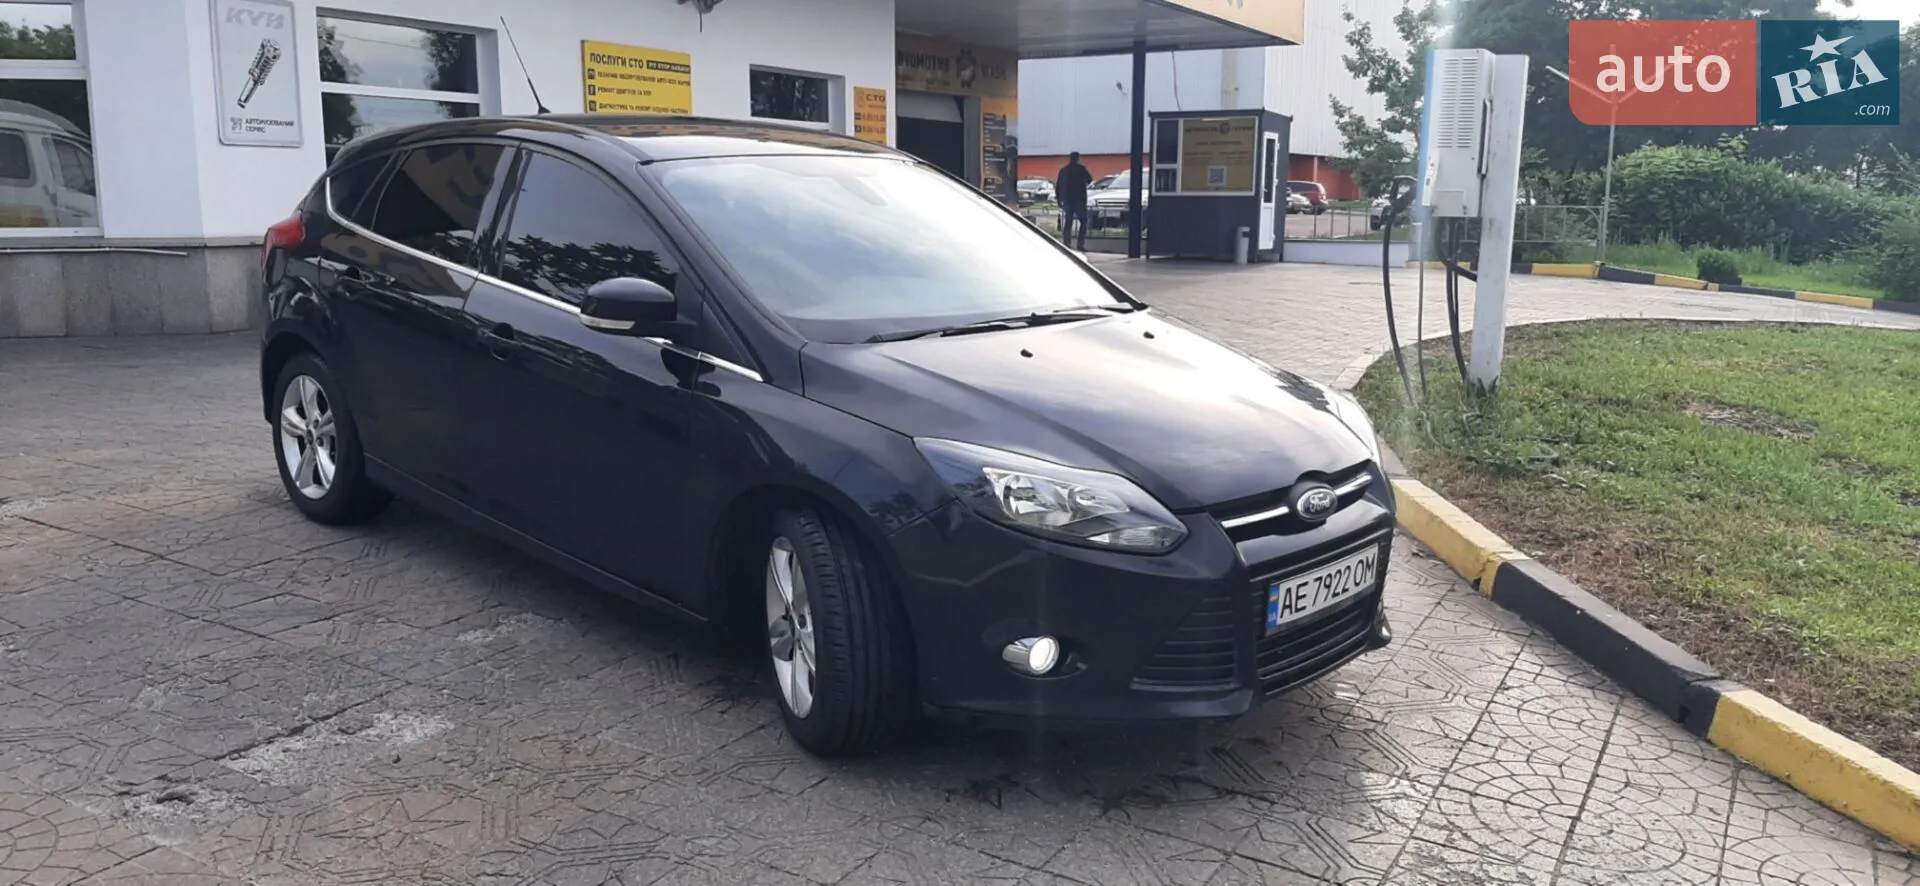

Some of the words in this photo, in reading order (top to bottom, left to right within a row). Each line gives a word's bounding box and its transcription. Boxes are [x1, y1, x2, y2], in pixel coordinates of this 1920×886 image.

[590, 52, 627, 67] ПОСЛУГИ
[628, 57, 644, 69] СТО
[866, 93, 886, 103] СТО
[1309, 493, 1331, 513] Ford
[1279, 580, 1309, 619] AE
[1311, 564, 1352, 608] 7922
[1353, 552, 1376, 587] OM
